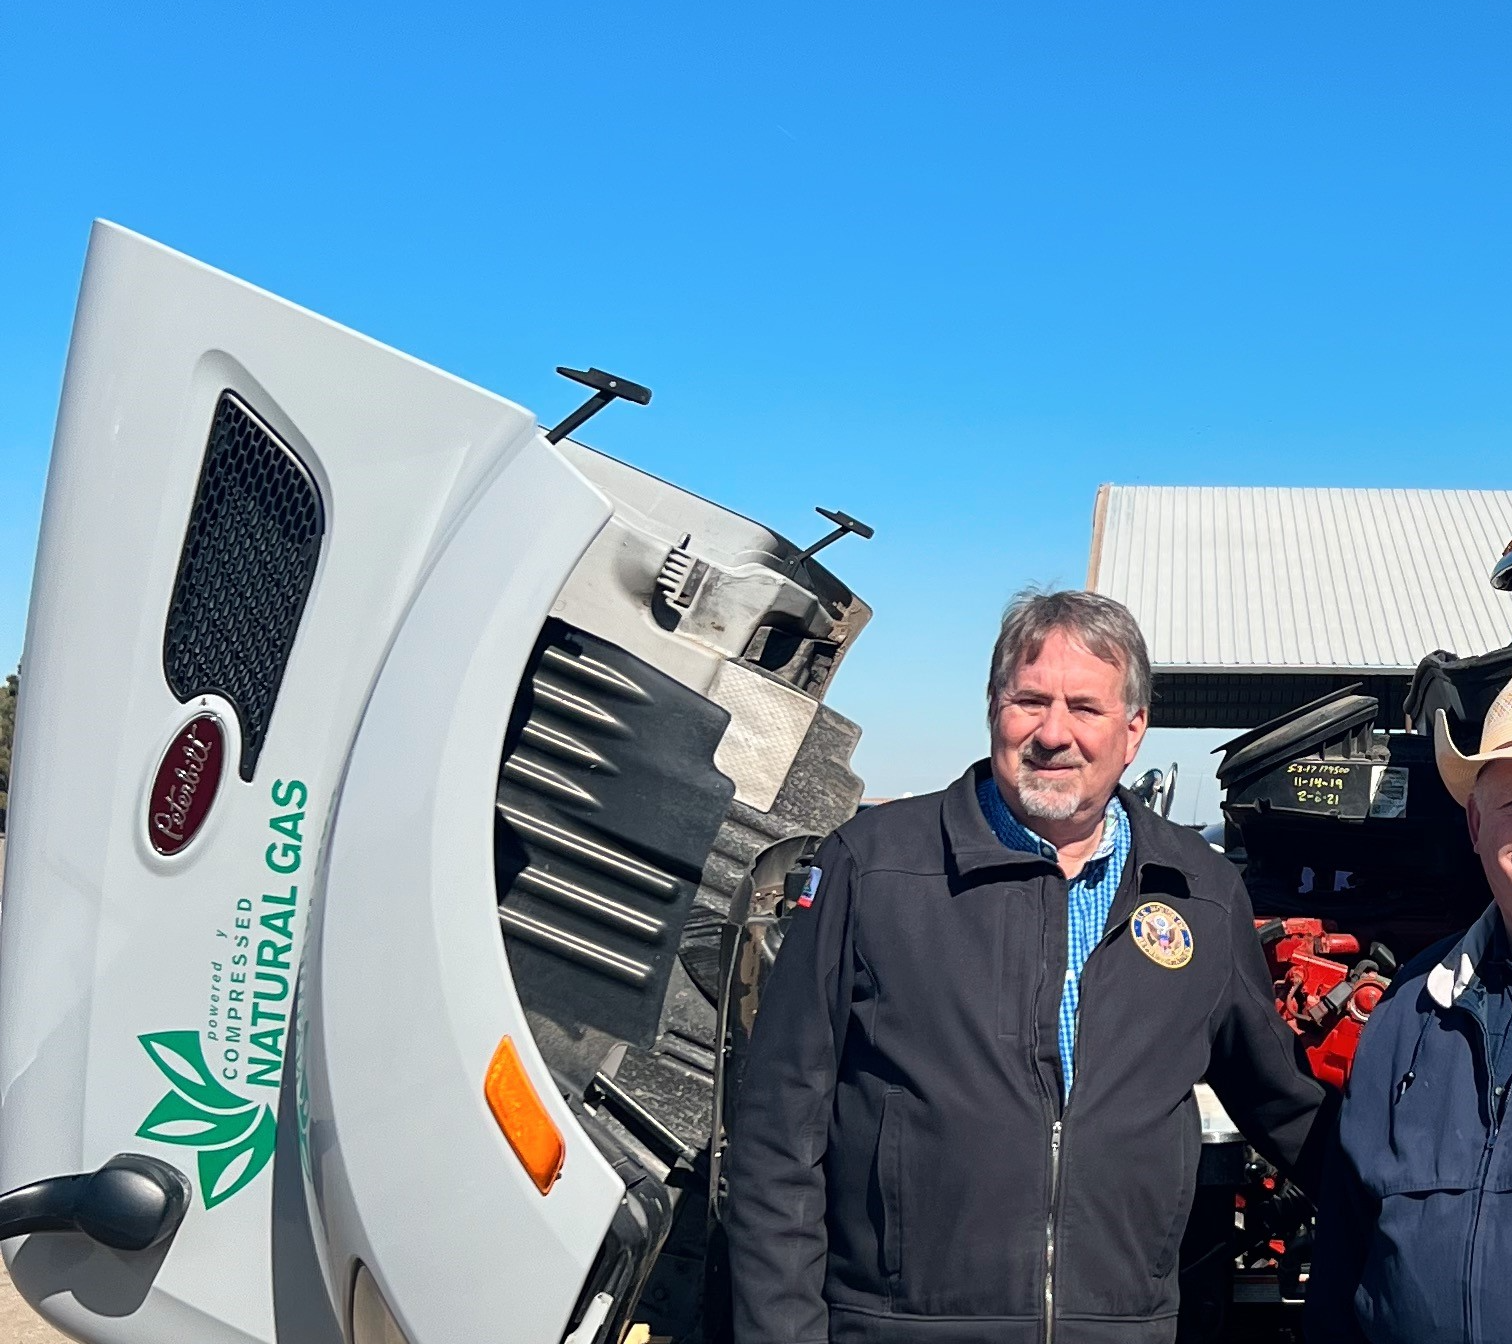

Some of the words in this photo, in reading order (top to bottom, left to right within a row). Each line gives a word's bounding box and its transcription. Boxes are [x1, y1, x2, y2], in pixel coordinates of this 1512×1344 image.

[154, 723, 212, 841] Peterbilt
[265, 778, 308, 874] GAS
[207, 961, 223, 1041] powered
[222, 898, 252, 1080] COMPRESSED
[246, 885, 298, 1087] NATURAL
